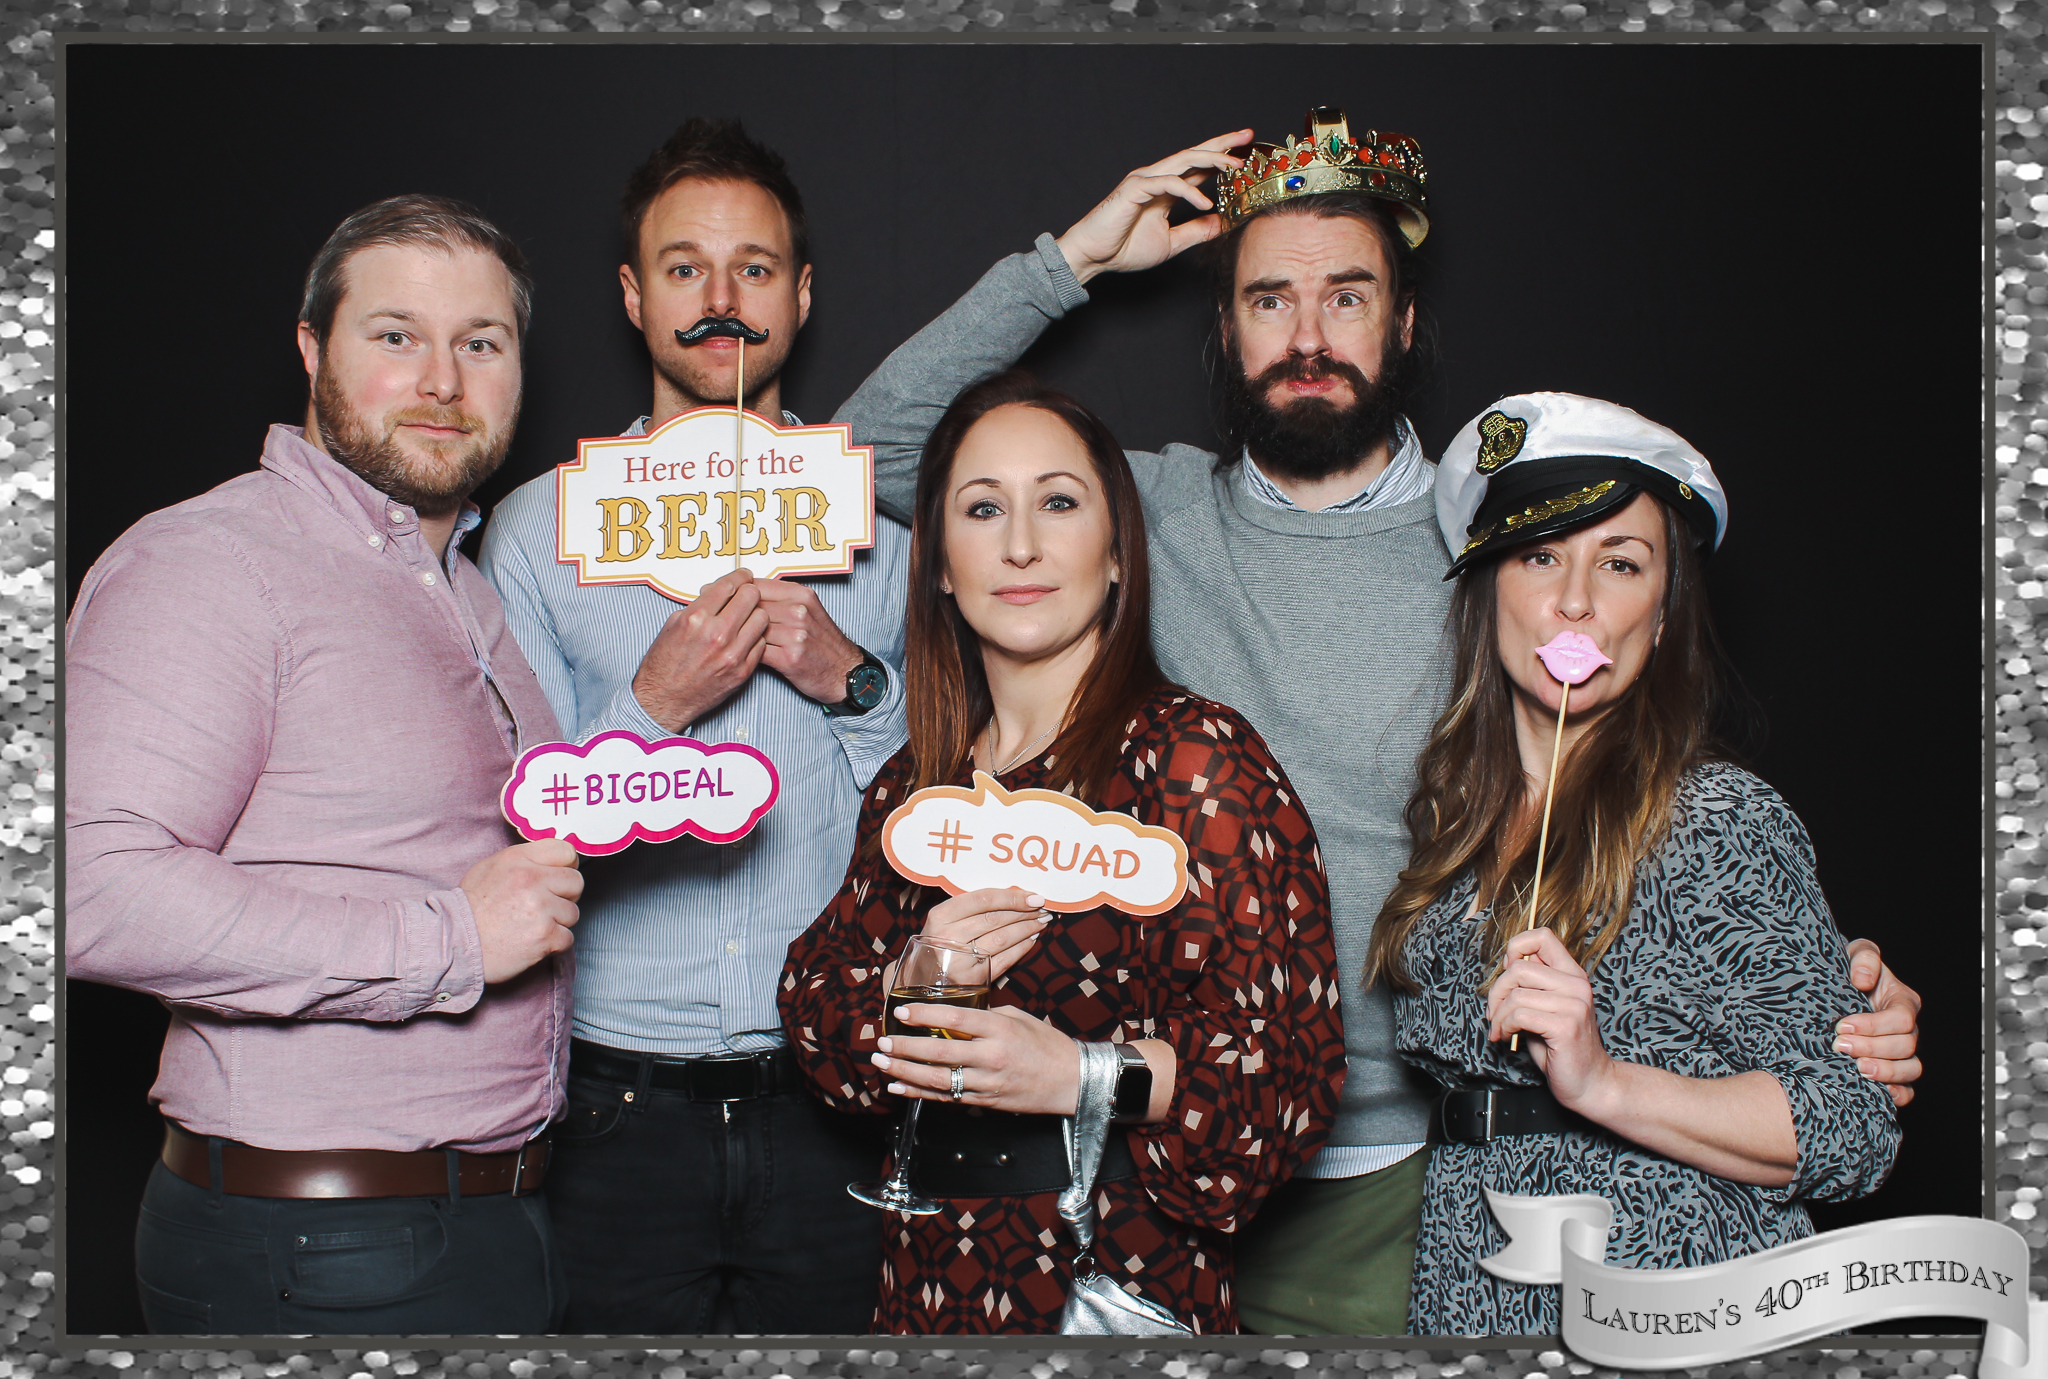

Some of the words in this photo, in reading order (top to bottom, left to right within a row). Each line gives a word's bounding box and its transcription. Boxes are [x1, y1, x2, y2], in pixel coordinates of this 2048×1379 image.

[623, 456, 696, 483] Here
[705, 452, 749, 478] for
[758, 448, 804, 475] the
[596, 486, 835, 563] BEER
[542, 767, 734, 816] #BIGDEAL
[988, 833, 1140, 879] SQUAD
